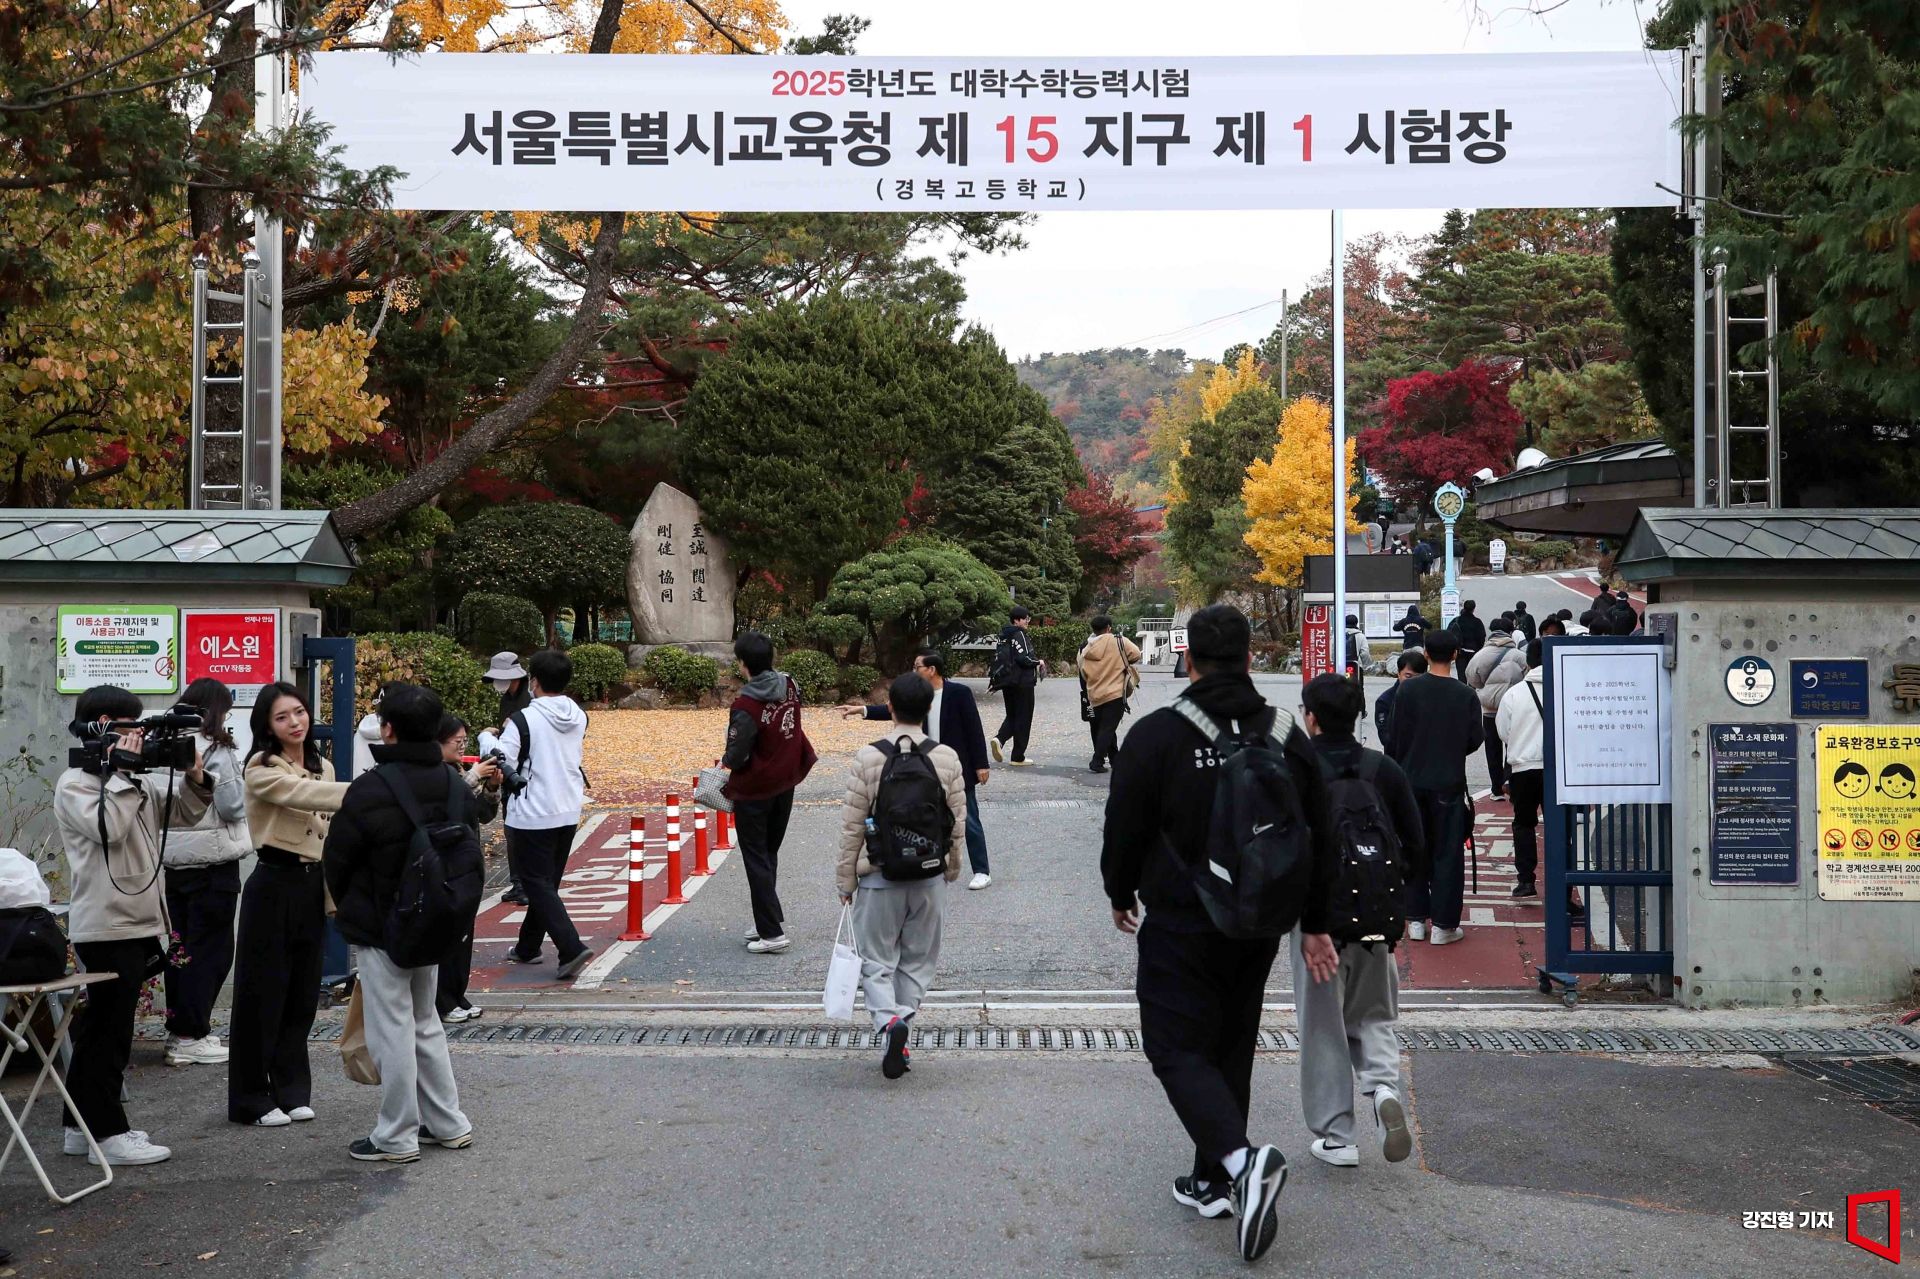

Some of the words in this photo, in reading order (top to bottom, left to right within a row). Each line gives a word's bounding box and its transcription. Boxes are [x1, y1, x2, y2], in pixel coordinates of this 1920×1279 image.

[771, 68, 936, 100] 2025학년도
[950, 68, 1190, 100] 대학수학능력시험
[450, 108, 893, 167] 서울특별시교육청
[916, 108, 969, 167] 제
[996, 114, 1059, 163] 15
[1082, 108, 1190, 167] 지구
[1213, 108, 1265, 167] 제
[1293, 114, 1313, 163] 1
[1344, 108, 1512, 167] 시험장
[76, 617, 111, 627] 이동소음
[113, 617, 148, 627] 규제지역
[151, 617, 159, 627] 및
[90, 628, 125, 637] 사용금지
[127, 628, 145, 637] 안내
[200, 635, 260, 659] 에스원
[209, 665, 230, 673] CCTV
[231, 665, 252, 673] 작동중
[1744, 677, 1756, 691] 9
[1745, 734, 1760, 742] 소재
[1826, 864, 1843, 873] 학교
[1846, 864, 1903, 873] 경계선으로부터
